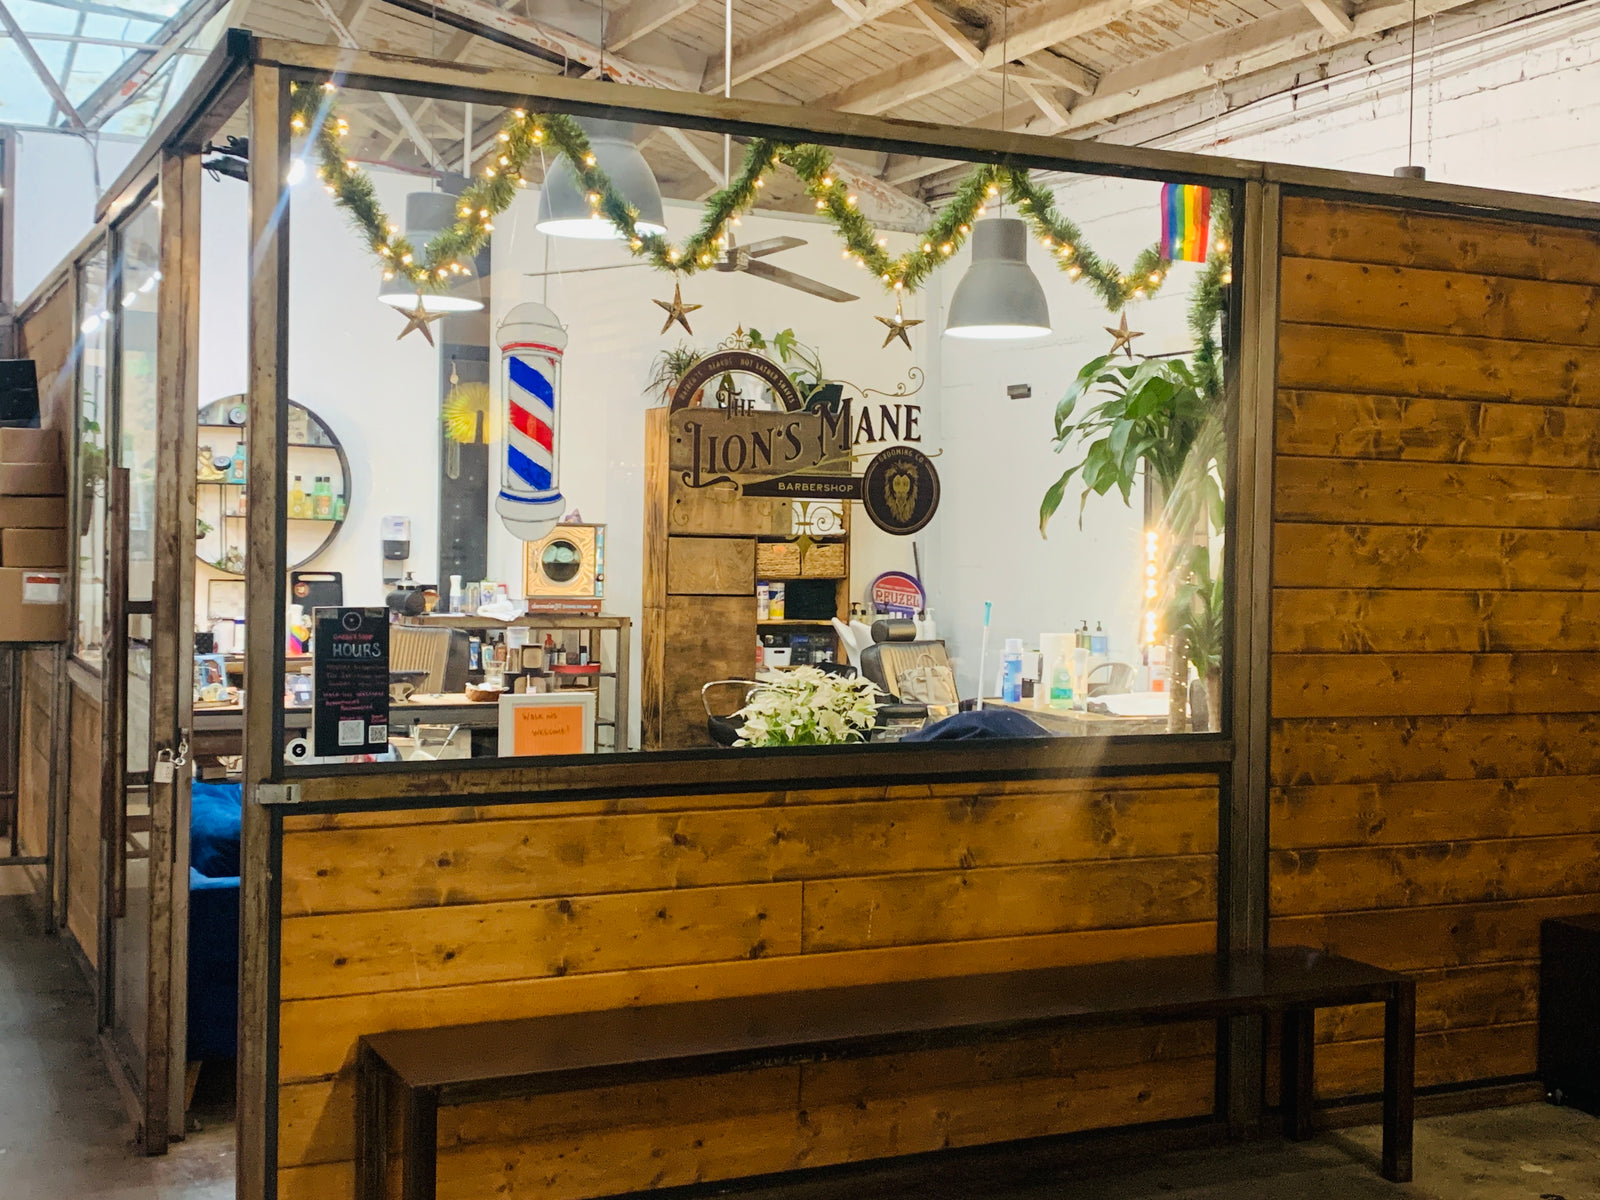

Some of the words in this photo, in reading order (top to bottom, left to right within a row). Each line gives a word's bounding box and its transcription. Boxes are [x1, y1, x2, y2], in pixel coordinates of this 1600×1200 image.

[813, 398, 922, 466] MANE
[879, 448, 913, 462] GROOMING
[778, 481, 854, 494] BARBERSHOP
[876, 590, 920, 607] REUZEL
[333, 643, 381, 657] HOURS
